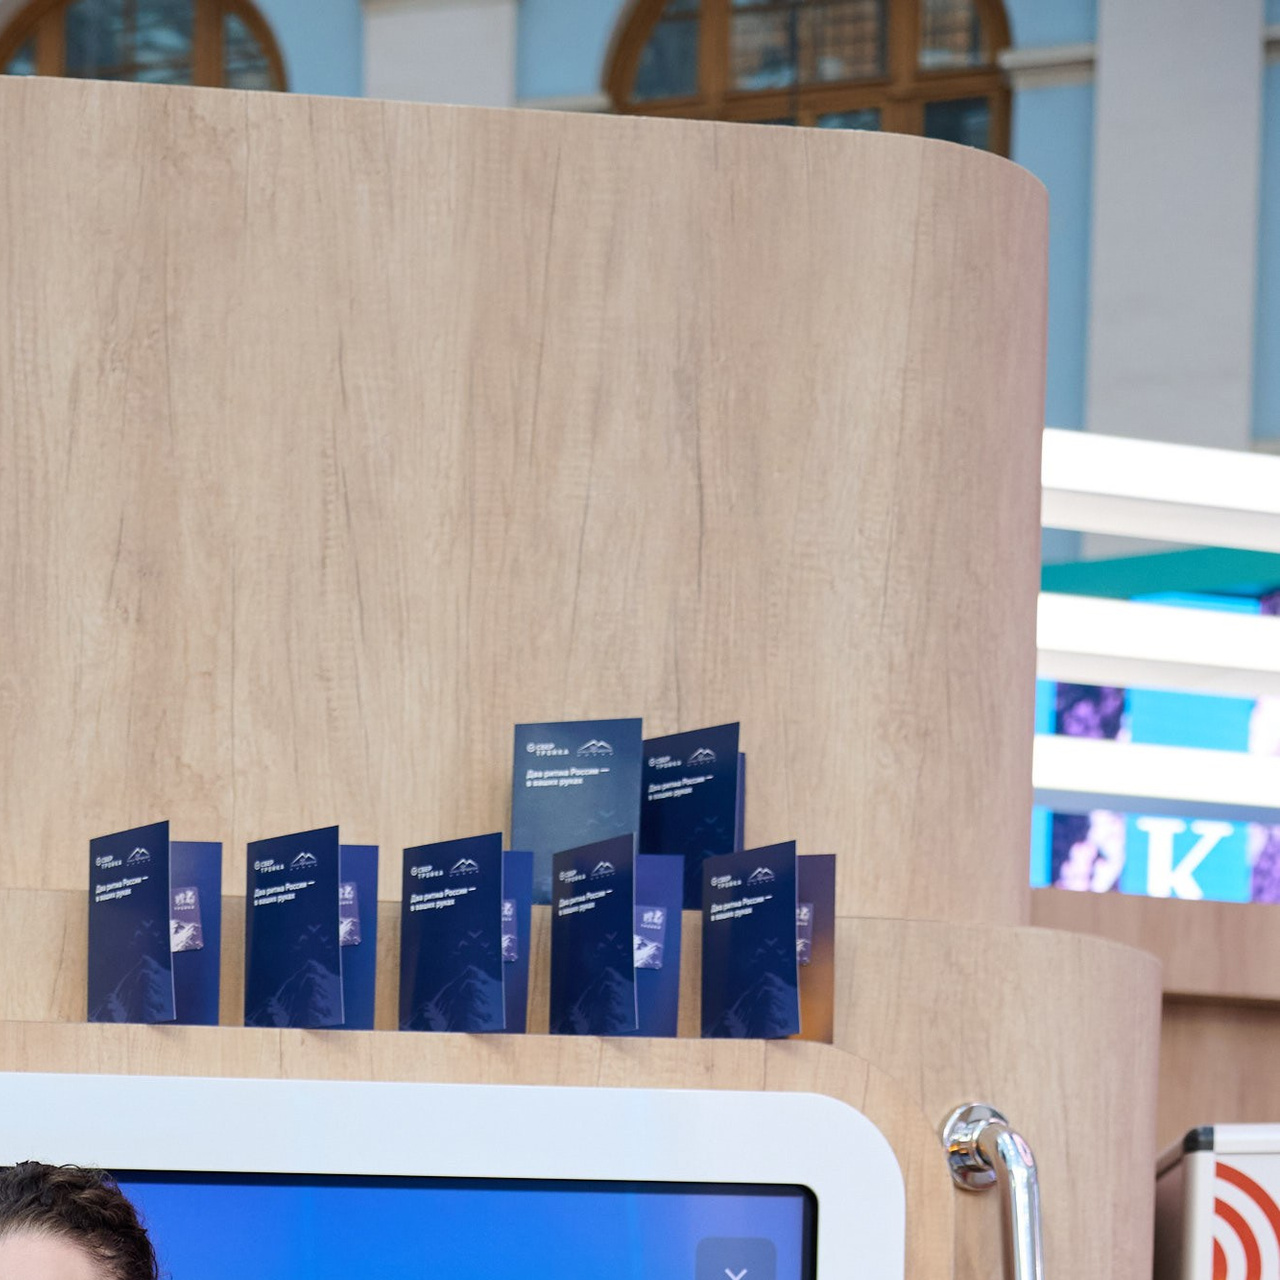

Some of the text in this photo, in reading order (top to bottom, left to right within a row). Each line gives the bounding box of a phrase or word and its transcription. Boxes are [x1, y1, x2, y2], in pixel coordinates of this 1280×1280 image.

[526, 768, 543, 780] Два
[570, 766, 599, 776] России
[285, 882, 307, 891] России
[410, 894, 424, 903] Два
[444, 888, 468, 897] России
